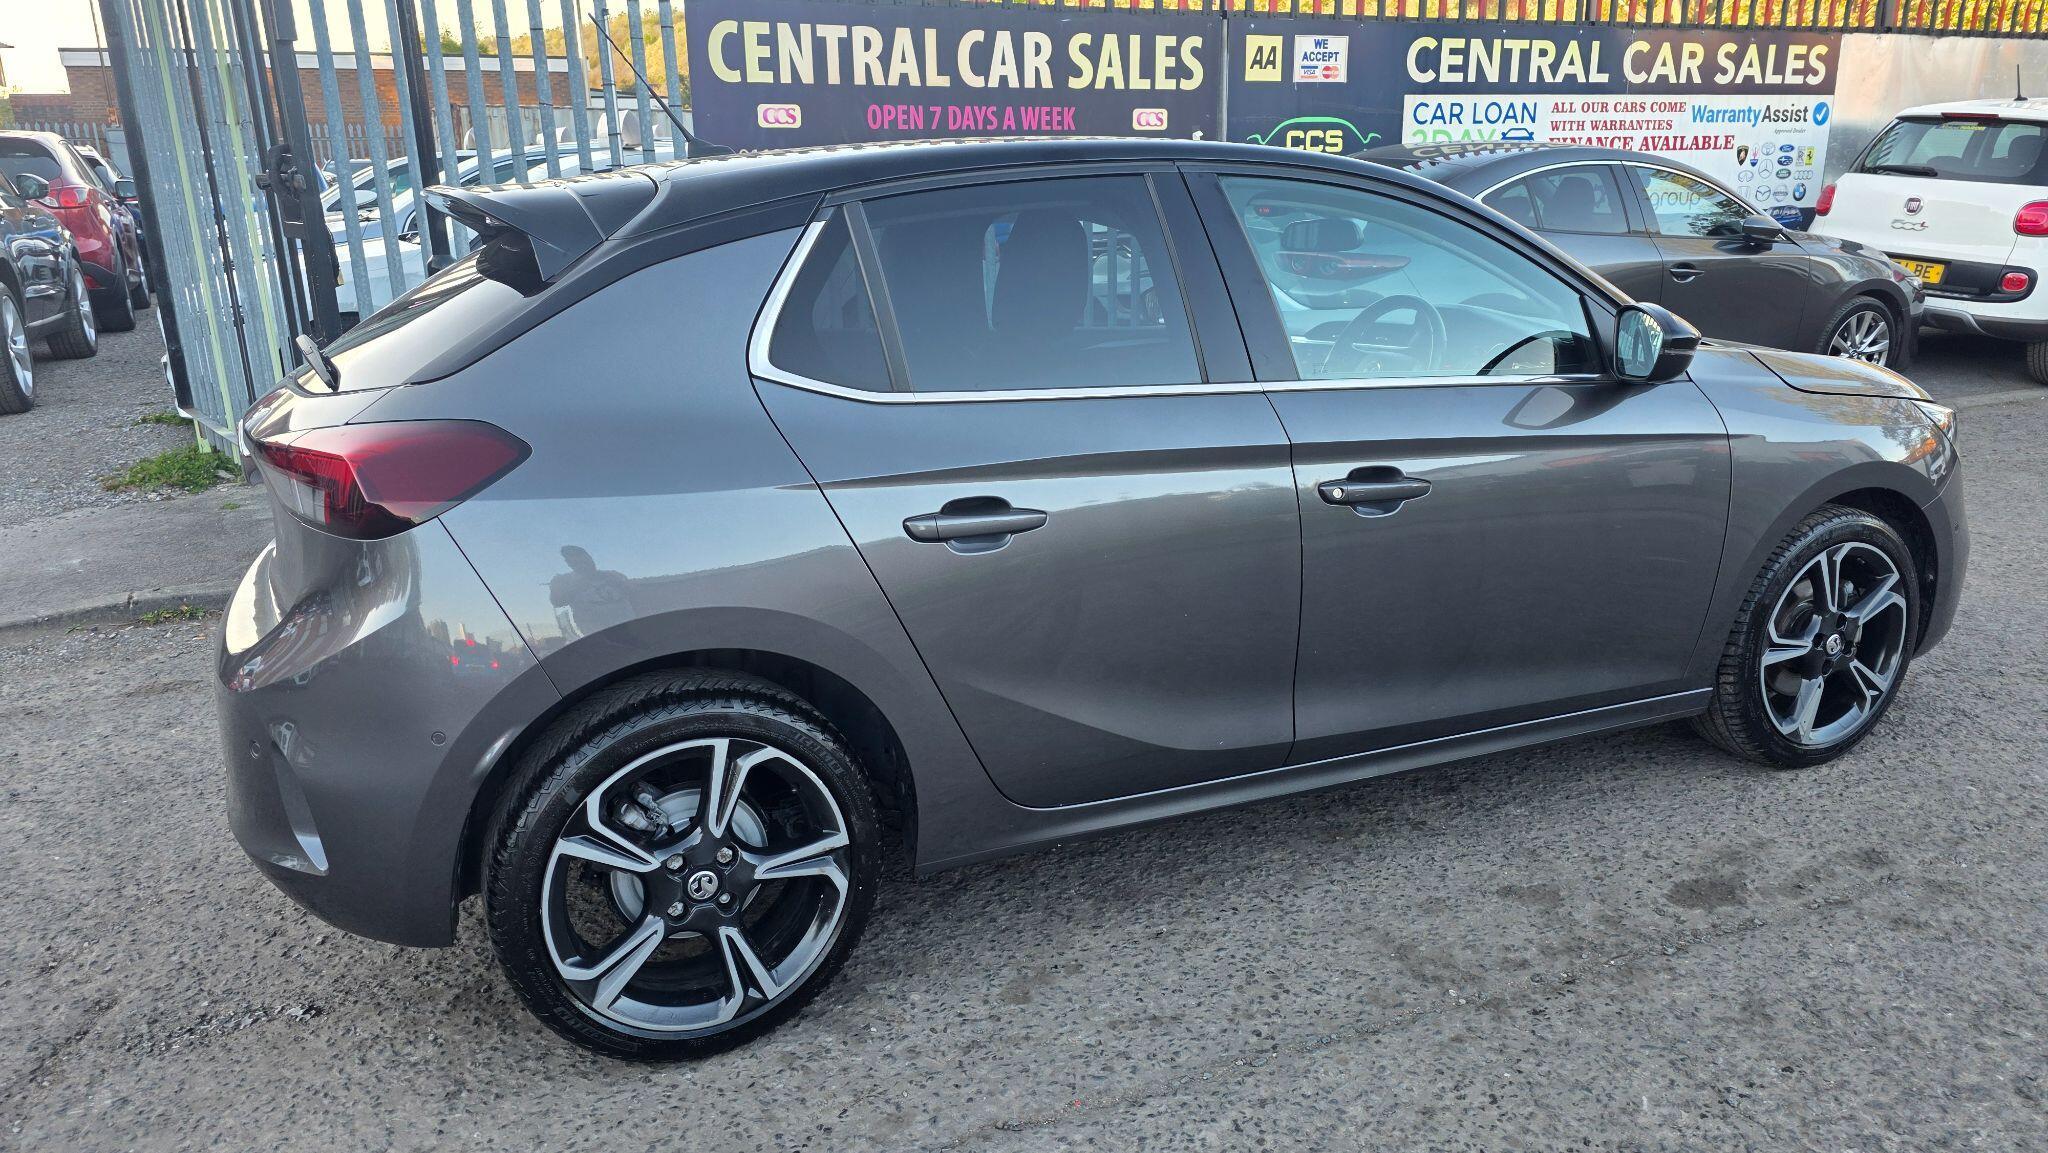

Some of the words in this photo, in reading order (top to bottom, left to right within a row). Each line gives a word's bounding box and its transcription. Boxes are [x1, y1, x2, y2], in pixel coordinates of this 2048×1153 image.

[1313, 38, 1329, 50] WE
[707, 20, 951, 87] CENTRAL
[957, 29, 1054, 89] CAR
[1067, 32, 1205, 91] SALES
[1249, 45, 1277, 70] AA
[1301, 51, 1340, 62] ACCEPT
[1406, 36, 1610, 84] CENTRAL
[1622, 40, 1705, 84] CAR
[1713, 41, 1829, 86] SALES
[762, 107, 797, 125] CCS
[1412, 101, 1464, 125] CAR
[1472, 101, 1538, 125] LOAN
[1551, 101, 1577, 113] ALL
[1581, 101, 1609, 113] OUR
[1613, 101, 1647, 113] CARS
[1650, 101, 1687, 113] COME
[867, 104, 924, 130] OPEN
[929, 106, 943, 130] 7
[948, 105, 998, 131] DAYS
[1002, 106, 1016, 130] A
[1019, 106, 1076, 131] WEEK
[1550, 120, 1586, 132] WITH
[1590, 119, 1673, 131] WARRANTIES
[1286, 129, 1344, 153] CCS
[1638, 134, 1736, 152] AVAILABLE
[1650, 191, 1701, 211] group
